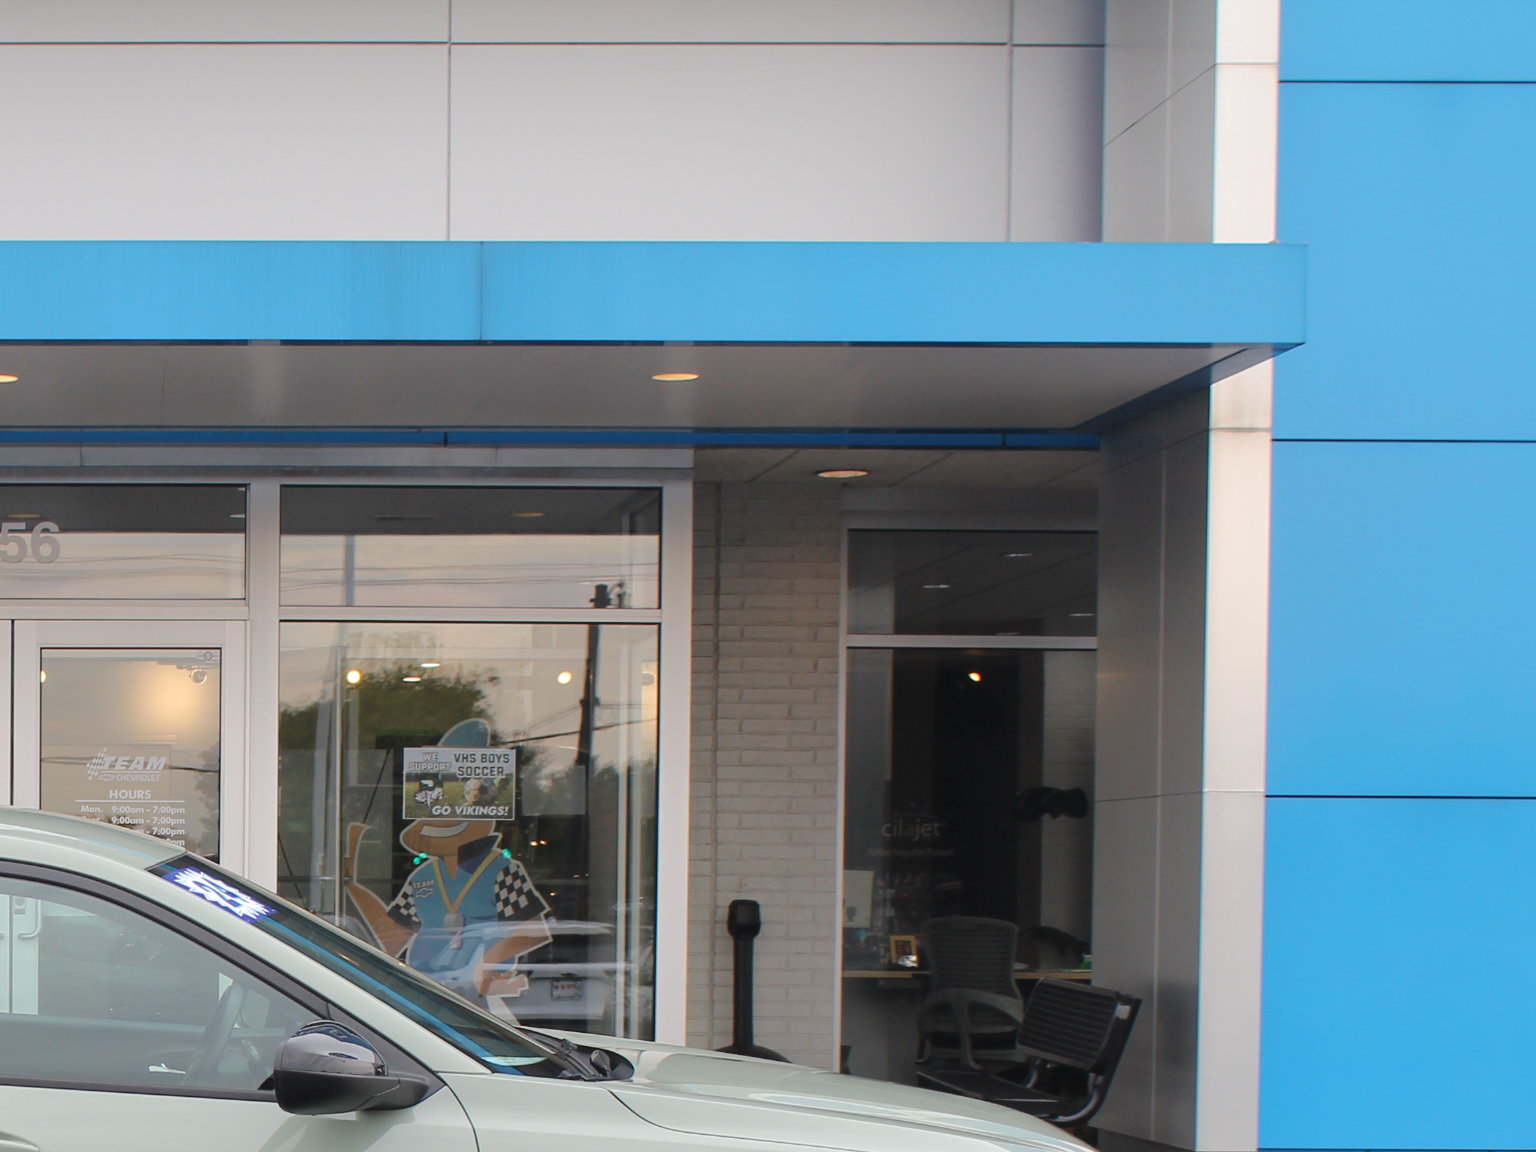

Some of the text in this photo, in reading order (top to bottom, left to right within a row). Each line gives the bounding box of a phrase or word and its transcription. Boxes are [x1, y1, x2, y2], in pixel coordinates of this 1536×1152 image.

[421, 751, 439, 761] WE
[453, 753, 510, 763] VHS BOYS
[102, 756, 168, 770] TEAM
[408, 762, 451, 771] SUPPORT
[457, 766, 505, 777] SOCCER
[116, 774, 161, 782] CHEVROLET
[108, 790, 152, 800] HOURS
[80, 805, 103, 813] Mon.
[111, 806, 144, 814] 9:00am
[152, 806, 186, 815] 7:00pm
[431, 805, 509, 816] GO VIKINGS!
[111, 816, 144, 824] 9:00am
[152, 817, 186, 826] 7:00pm
[152, 827, 186, 837] 7:00pm
[880, 818, 941, 842] cilajet
[413, 880, 434, 889] TEAM
